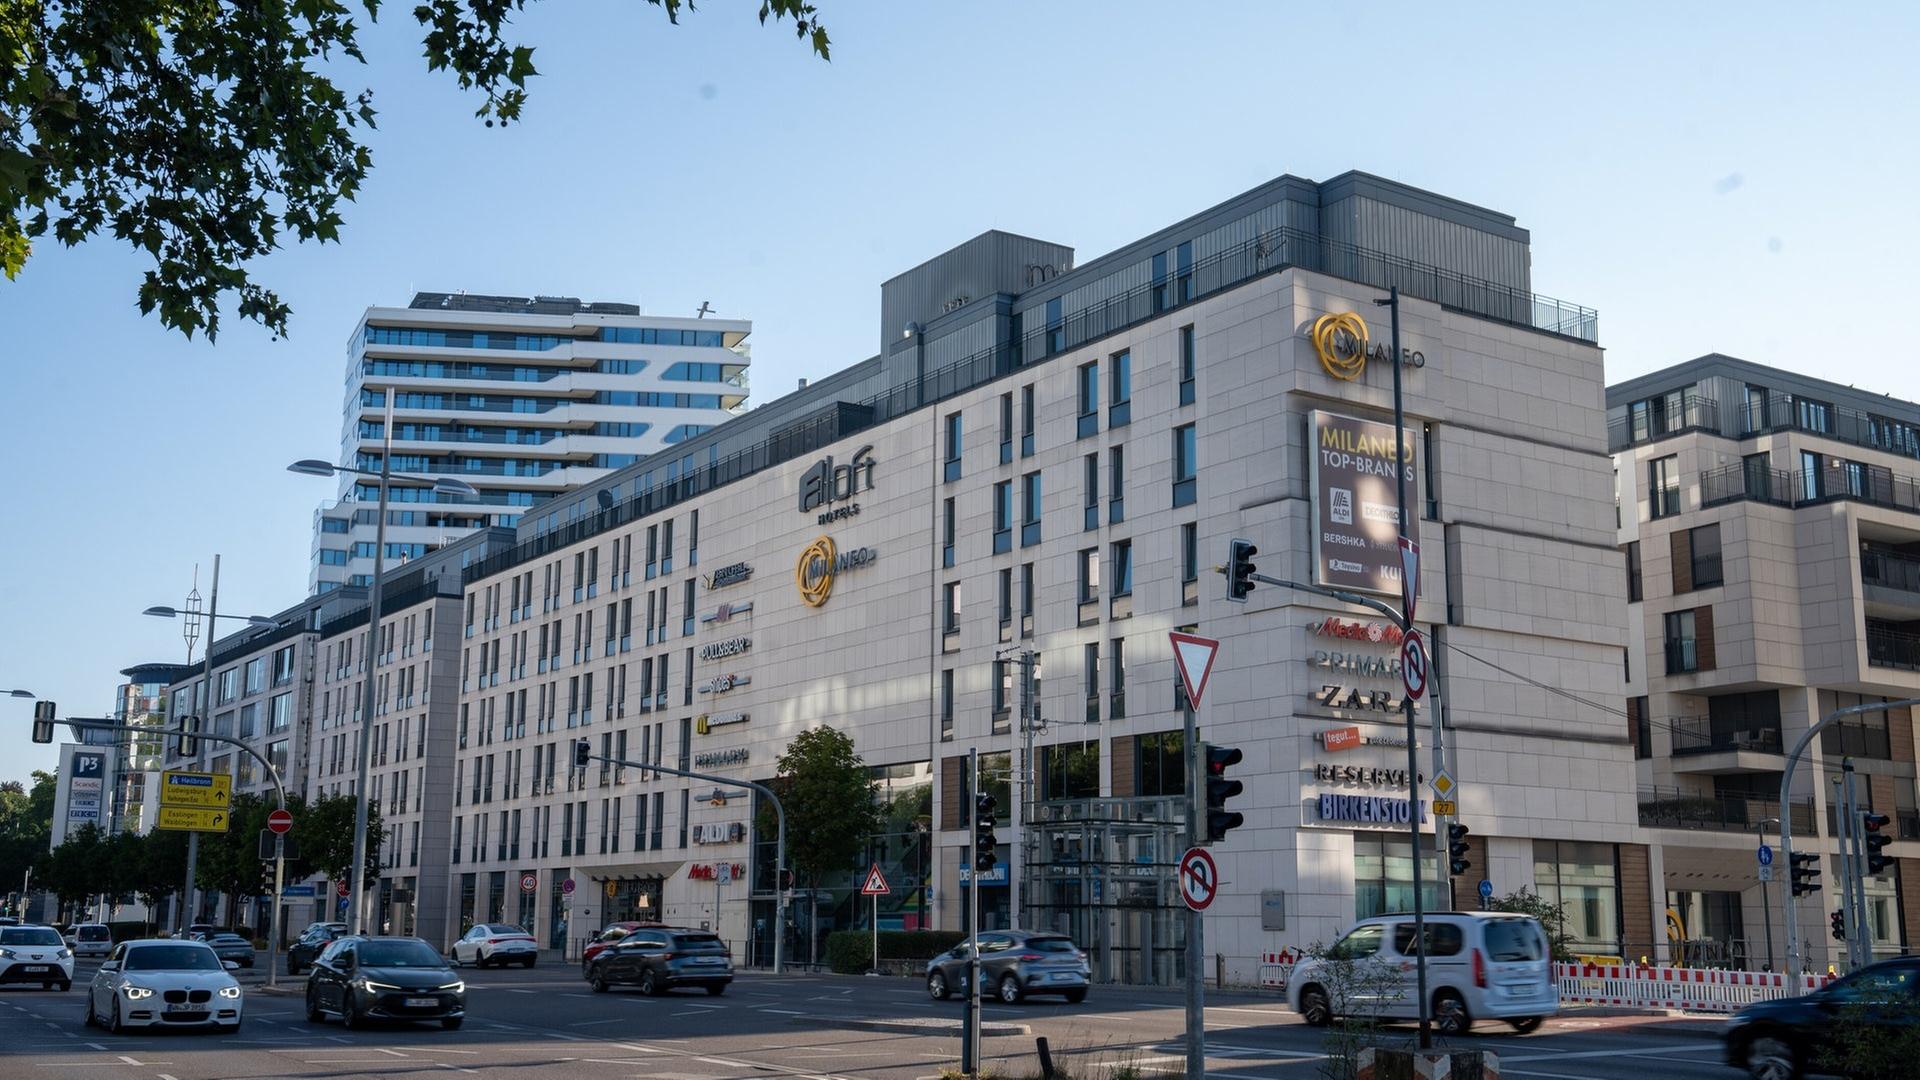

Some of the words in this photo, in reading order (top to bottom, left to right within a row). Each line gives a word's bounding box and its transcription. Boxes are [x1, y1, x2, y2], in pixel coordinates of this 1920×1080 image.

[1322, 450, 1414, 482] TOP-BRANS
[818, 503, 861, 525] HOTELS
[1333, 508, 1350, 517] ALDI
[1324, 532, 1366, 548] BERSHKA
[701, 637, 746, 660] PULL&BEAR
[1315, 650, 1402, 679] PRIMAR
[79, 756, 98, 773] P3
[181, 777, 211, 785] Heilbronn
[1320, 794, 1427, 824] BIRKENSTOK
[1438, 803, 1449, 812] 27
[700, 823, 731, 843] ALDI
